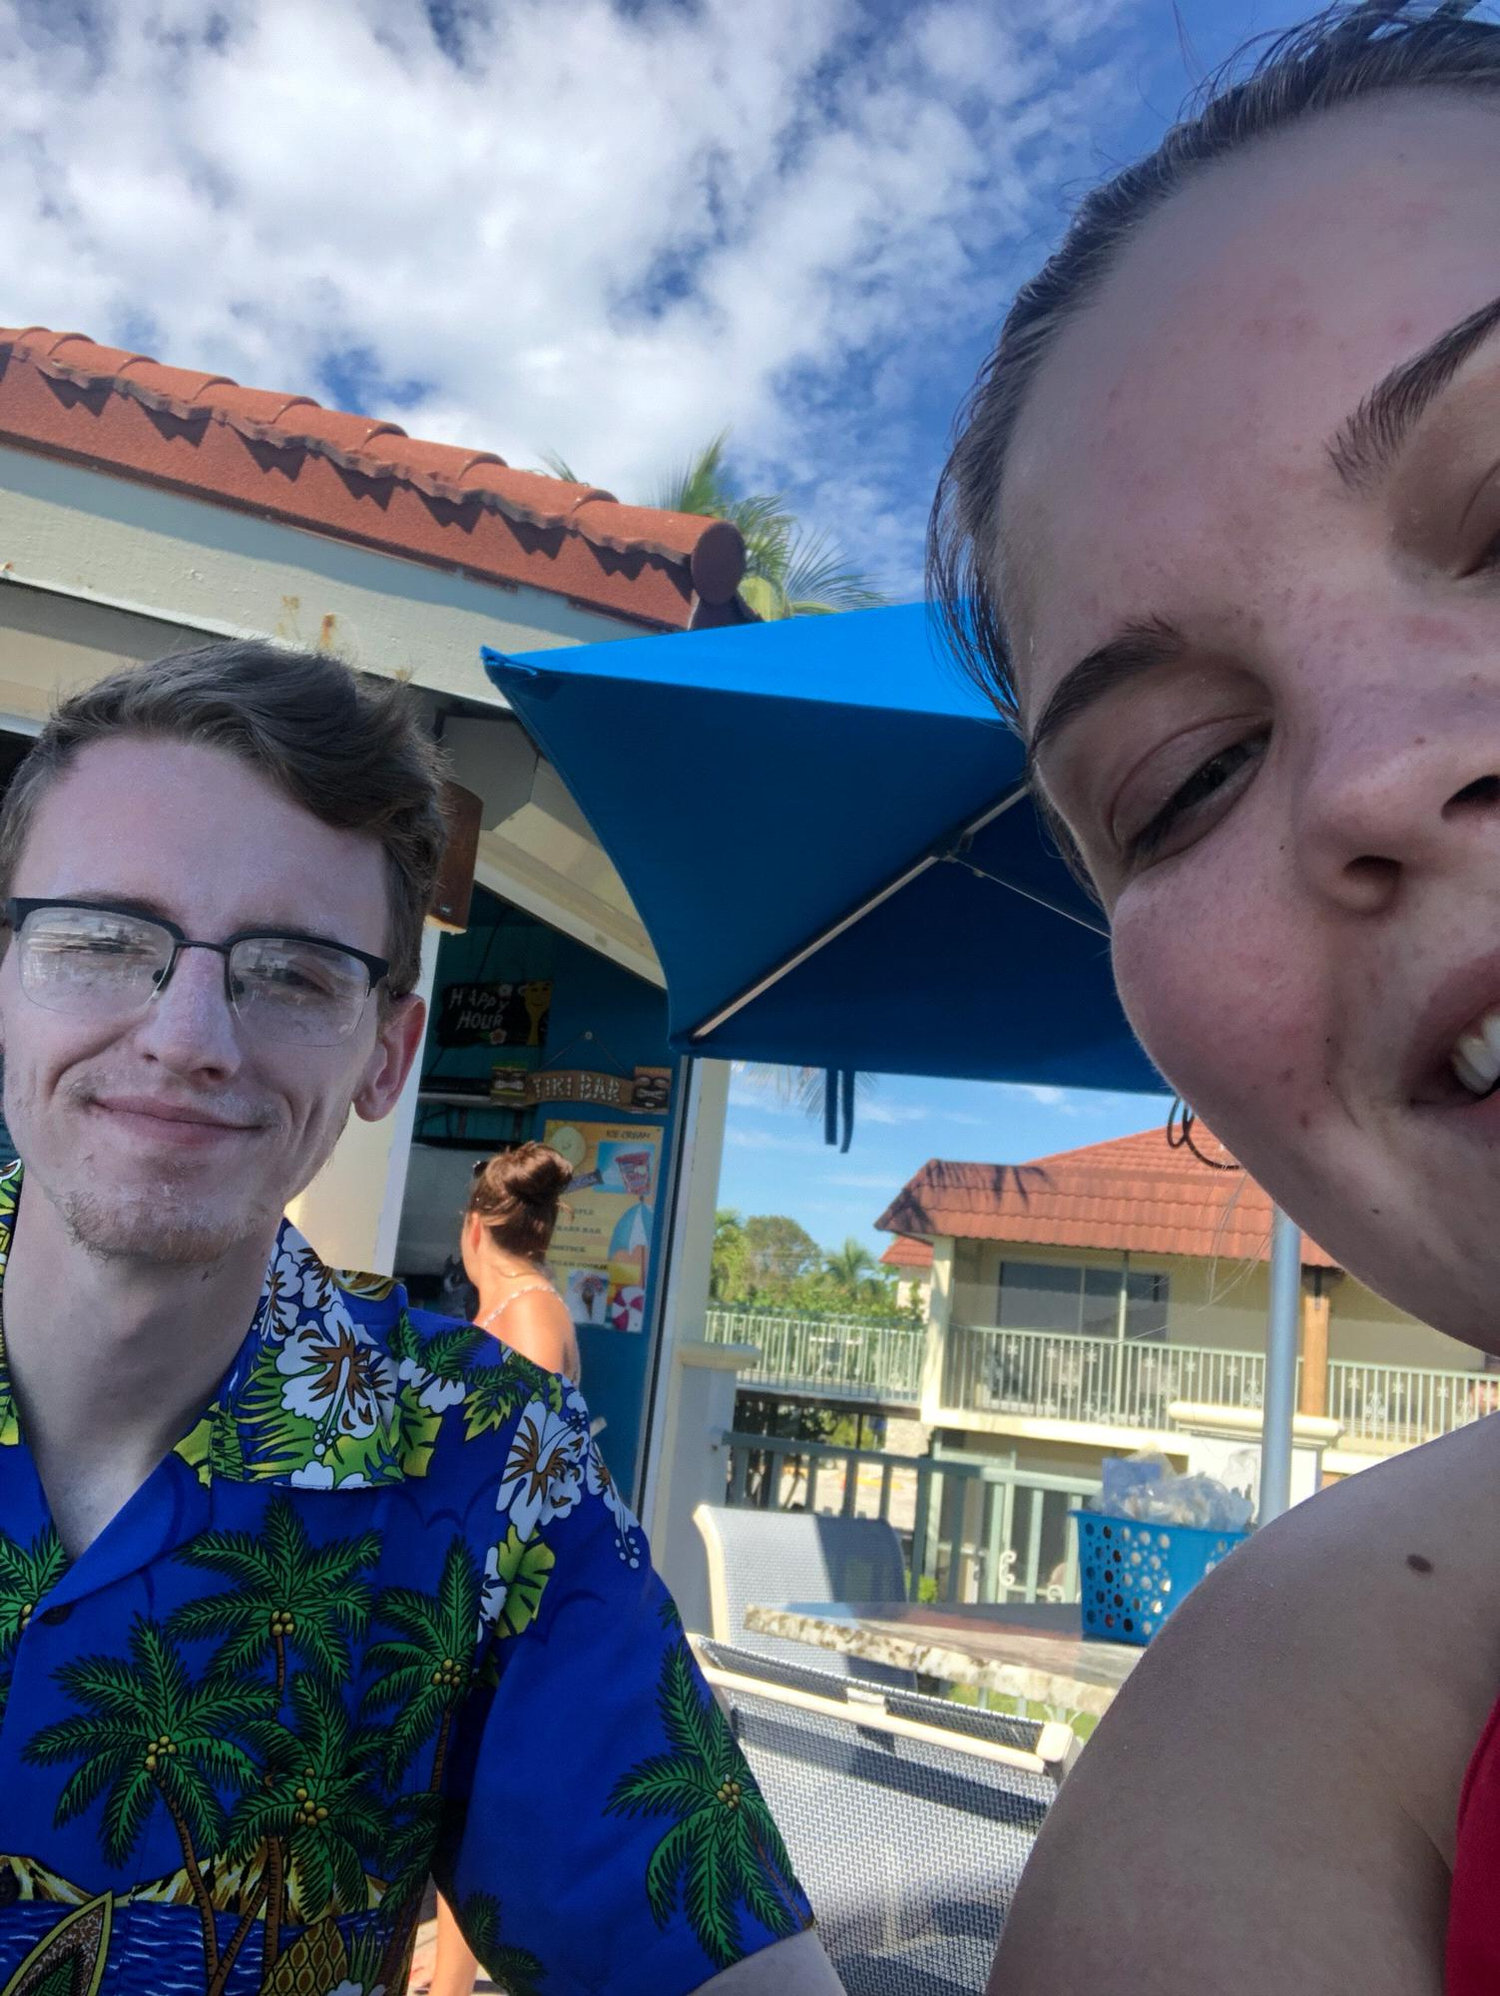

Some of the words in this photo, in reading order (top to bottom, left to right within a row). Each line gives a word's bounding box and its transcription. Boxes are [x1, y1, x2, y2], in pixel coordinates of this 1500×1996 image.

[455, 1010, 503, 1031] HOUR
[532, 1077, 572, 1099] TIKI
[580, 1073, 620, 1102] BAR
